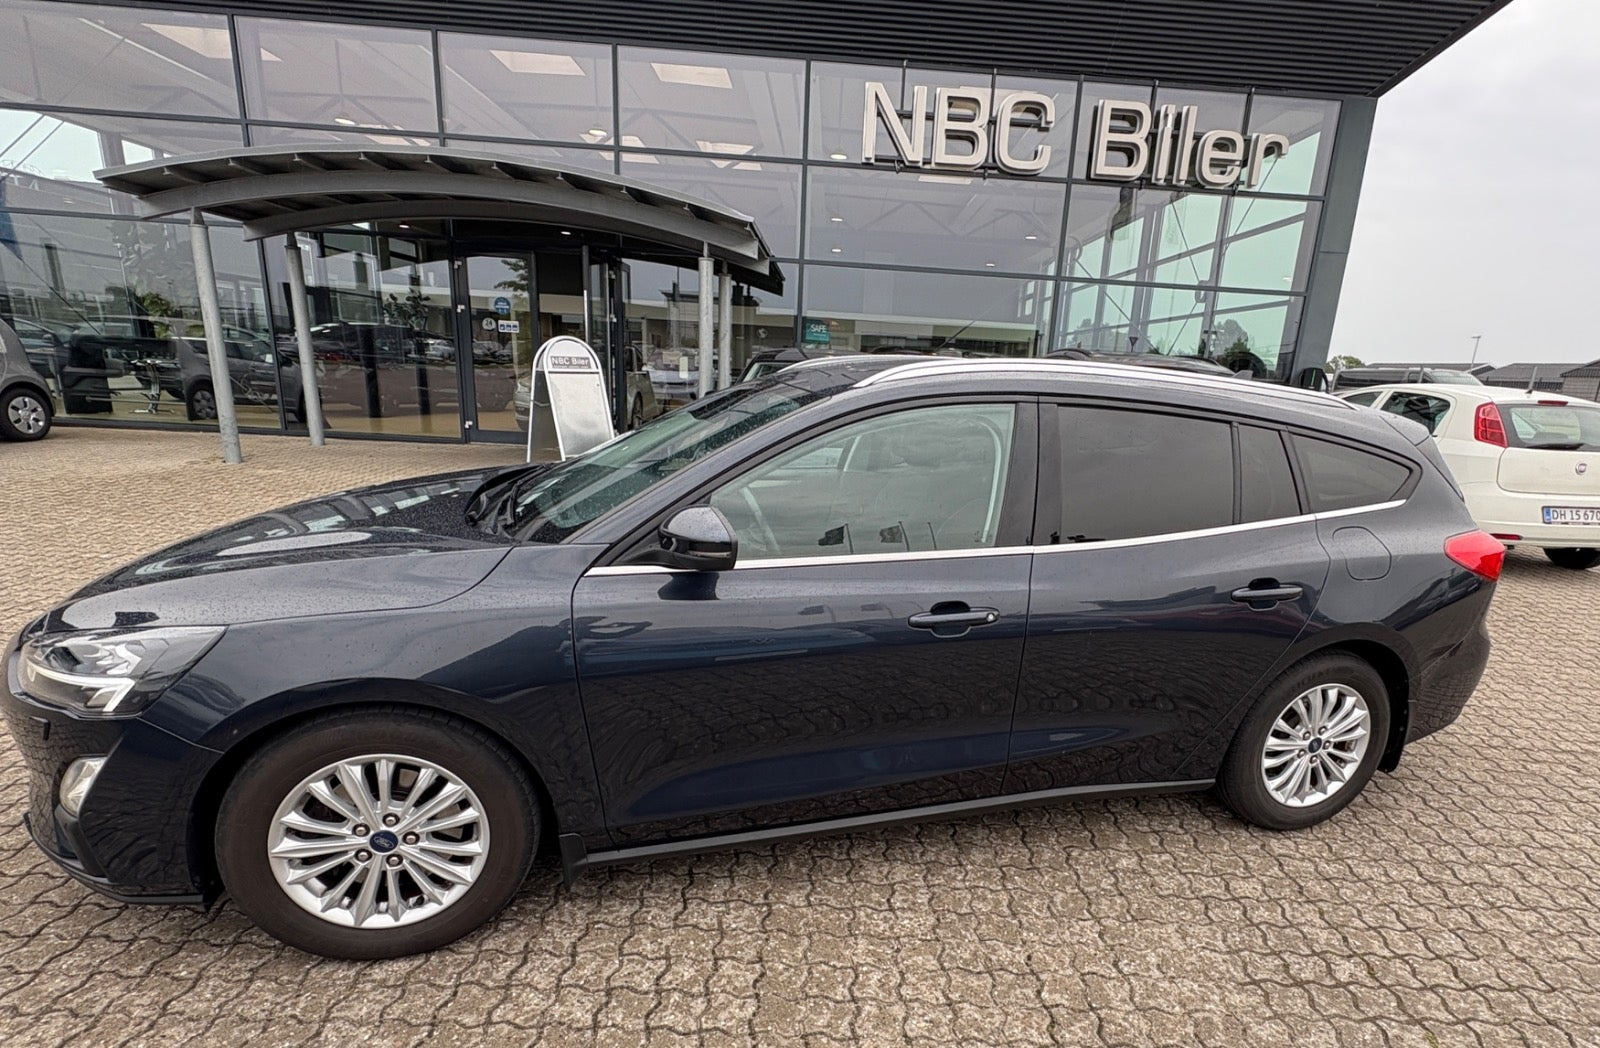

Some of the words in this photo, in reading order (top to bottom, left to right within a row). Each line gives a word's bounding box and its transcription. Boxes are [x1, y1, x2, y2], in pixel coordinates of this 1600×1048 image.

[863, 81, 1056, 175] NBC
[1090, 98, 1290, 189] Biler
[551, 356, 570, 365] NBC
[1552, 509, 1566, 520] DH
[1569, 510, 1581, 521] 15
[1583, 510, 1600, 521] 670
